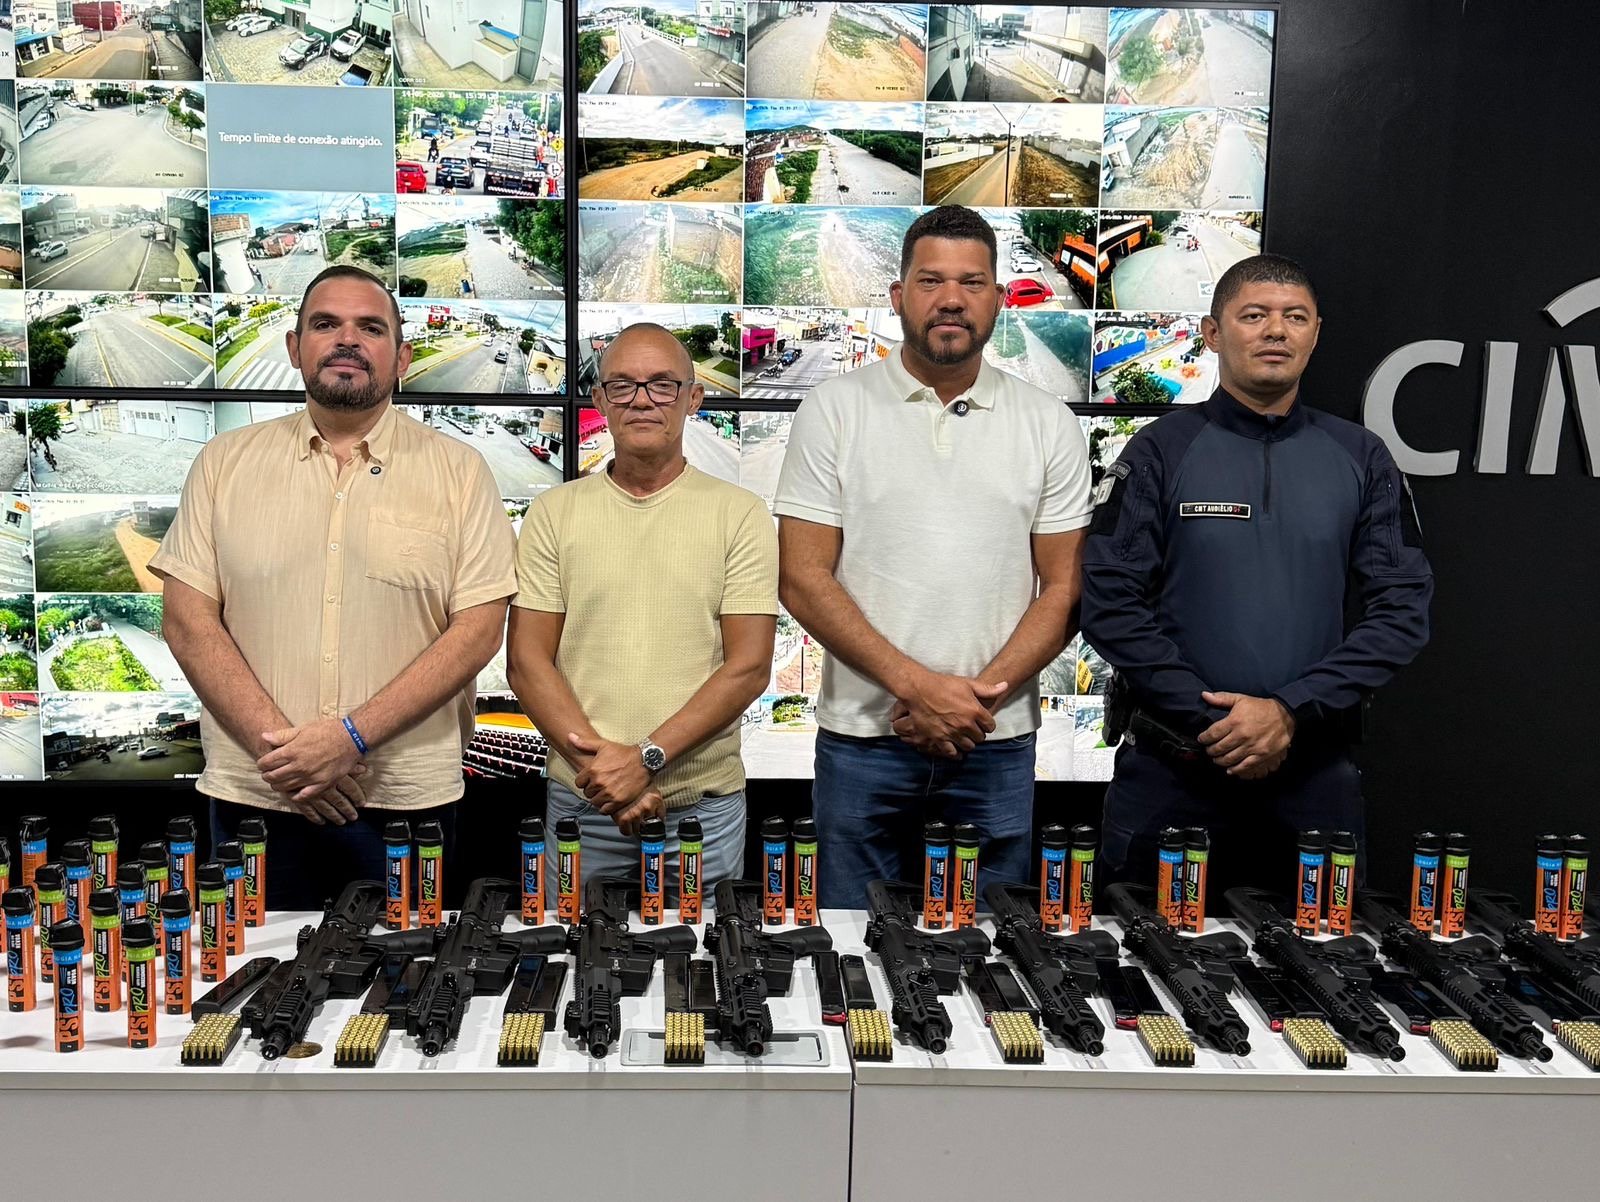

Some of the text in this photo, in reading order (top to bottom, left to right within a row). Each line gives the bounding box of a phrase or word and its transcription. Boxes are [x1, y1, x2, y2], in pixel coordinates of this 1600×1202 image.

[218, 131, 383, 148] Tempo limite de conexão atingido.
